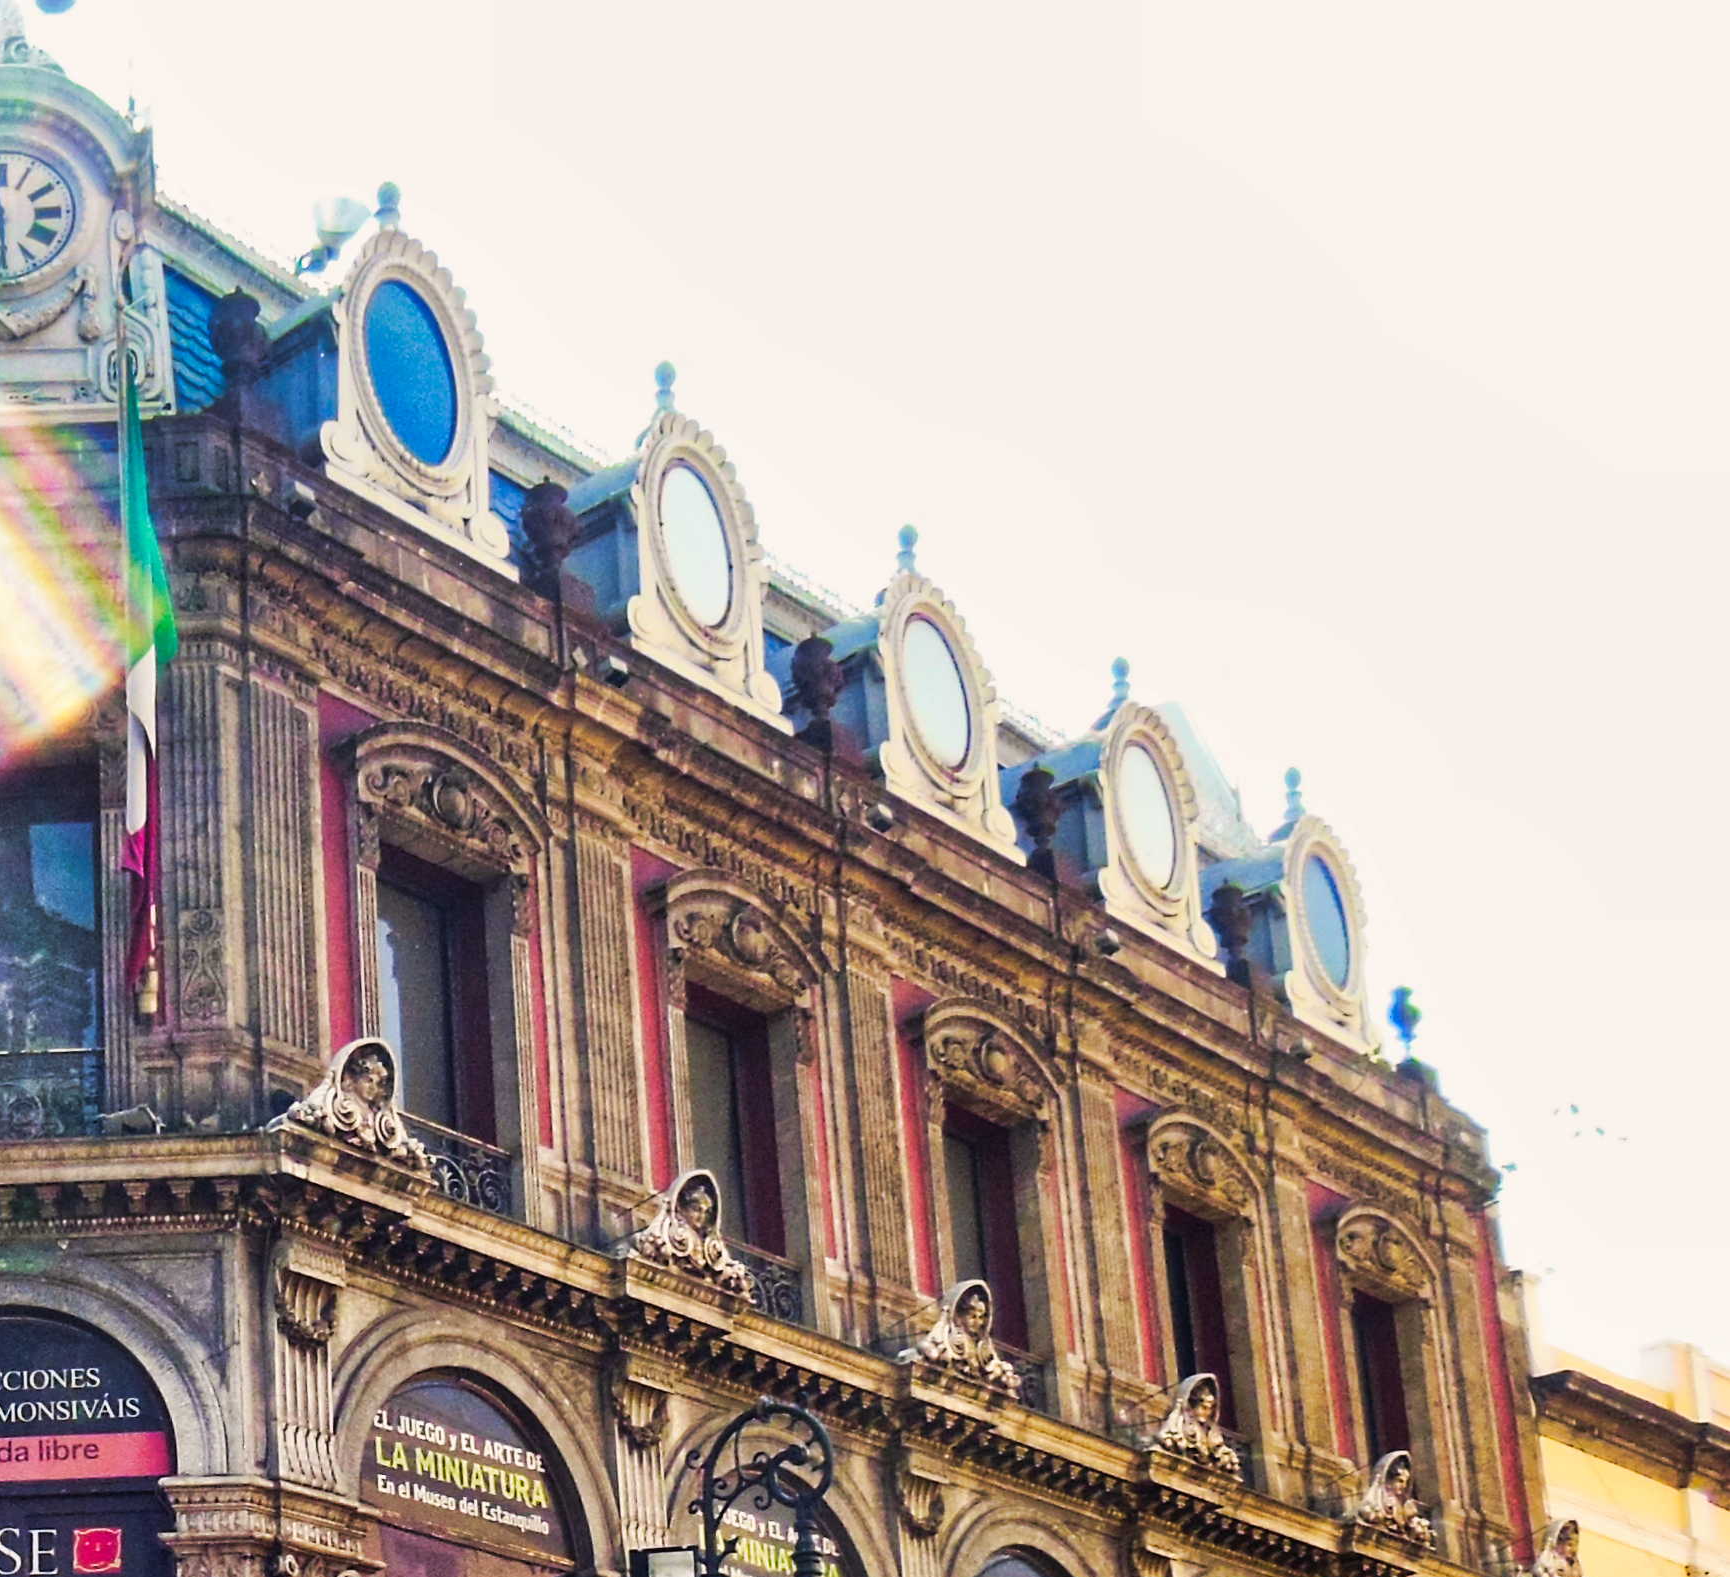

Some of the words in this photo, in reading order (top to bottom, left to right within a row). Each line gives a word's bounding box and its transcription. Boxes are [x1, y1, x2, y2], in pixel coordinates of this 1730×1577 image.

[37, 1437, 100, 1462] libre
[373, 1409, 394, 1431] EL
[396, 1414, 446, 1447] JUEGO
[448, 1434, 458, 1452] y
[460, 1432, 481, 1456] EL
[482, 1439, 525, 1468] ARTE
[525, 1451, 546, 1473] DE
[375, 1436, 410, 1472] LA
[414, 1446, 549, 1509] MINIATURA
[377, 1473, 396, 1496] En
[397, 1481, 411, 1500] el
[412, 1482, 457, 1511] Museo
[458, 1496, 479, 1517] del
[481, 1501, 550, 1536] Estanquillo
[768, 1520, 785, 1541] EL
